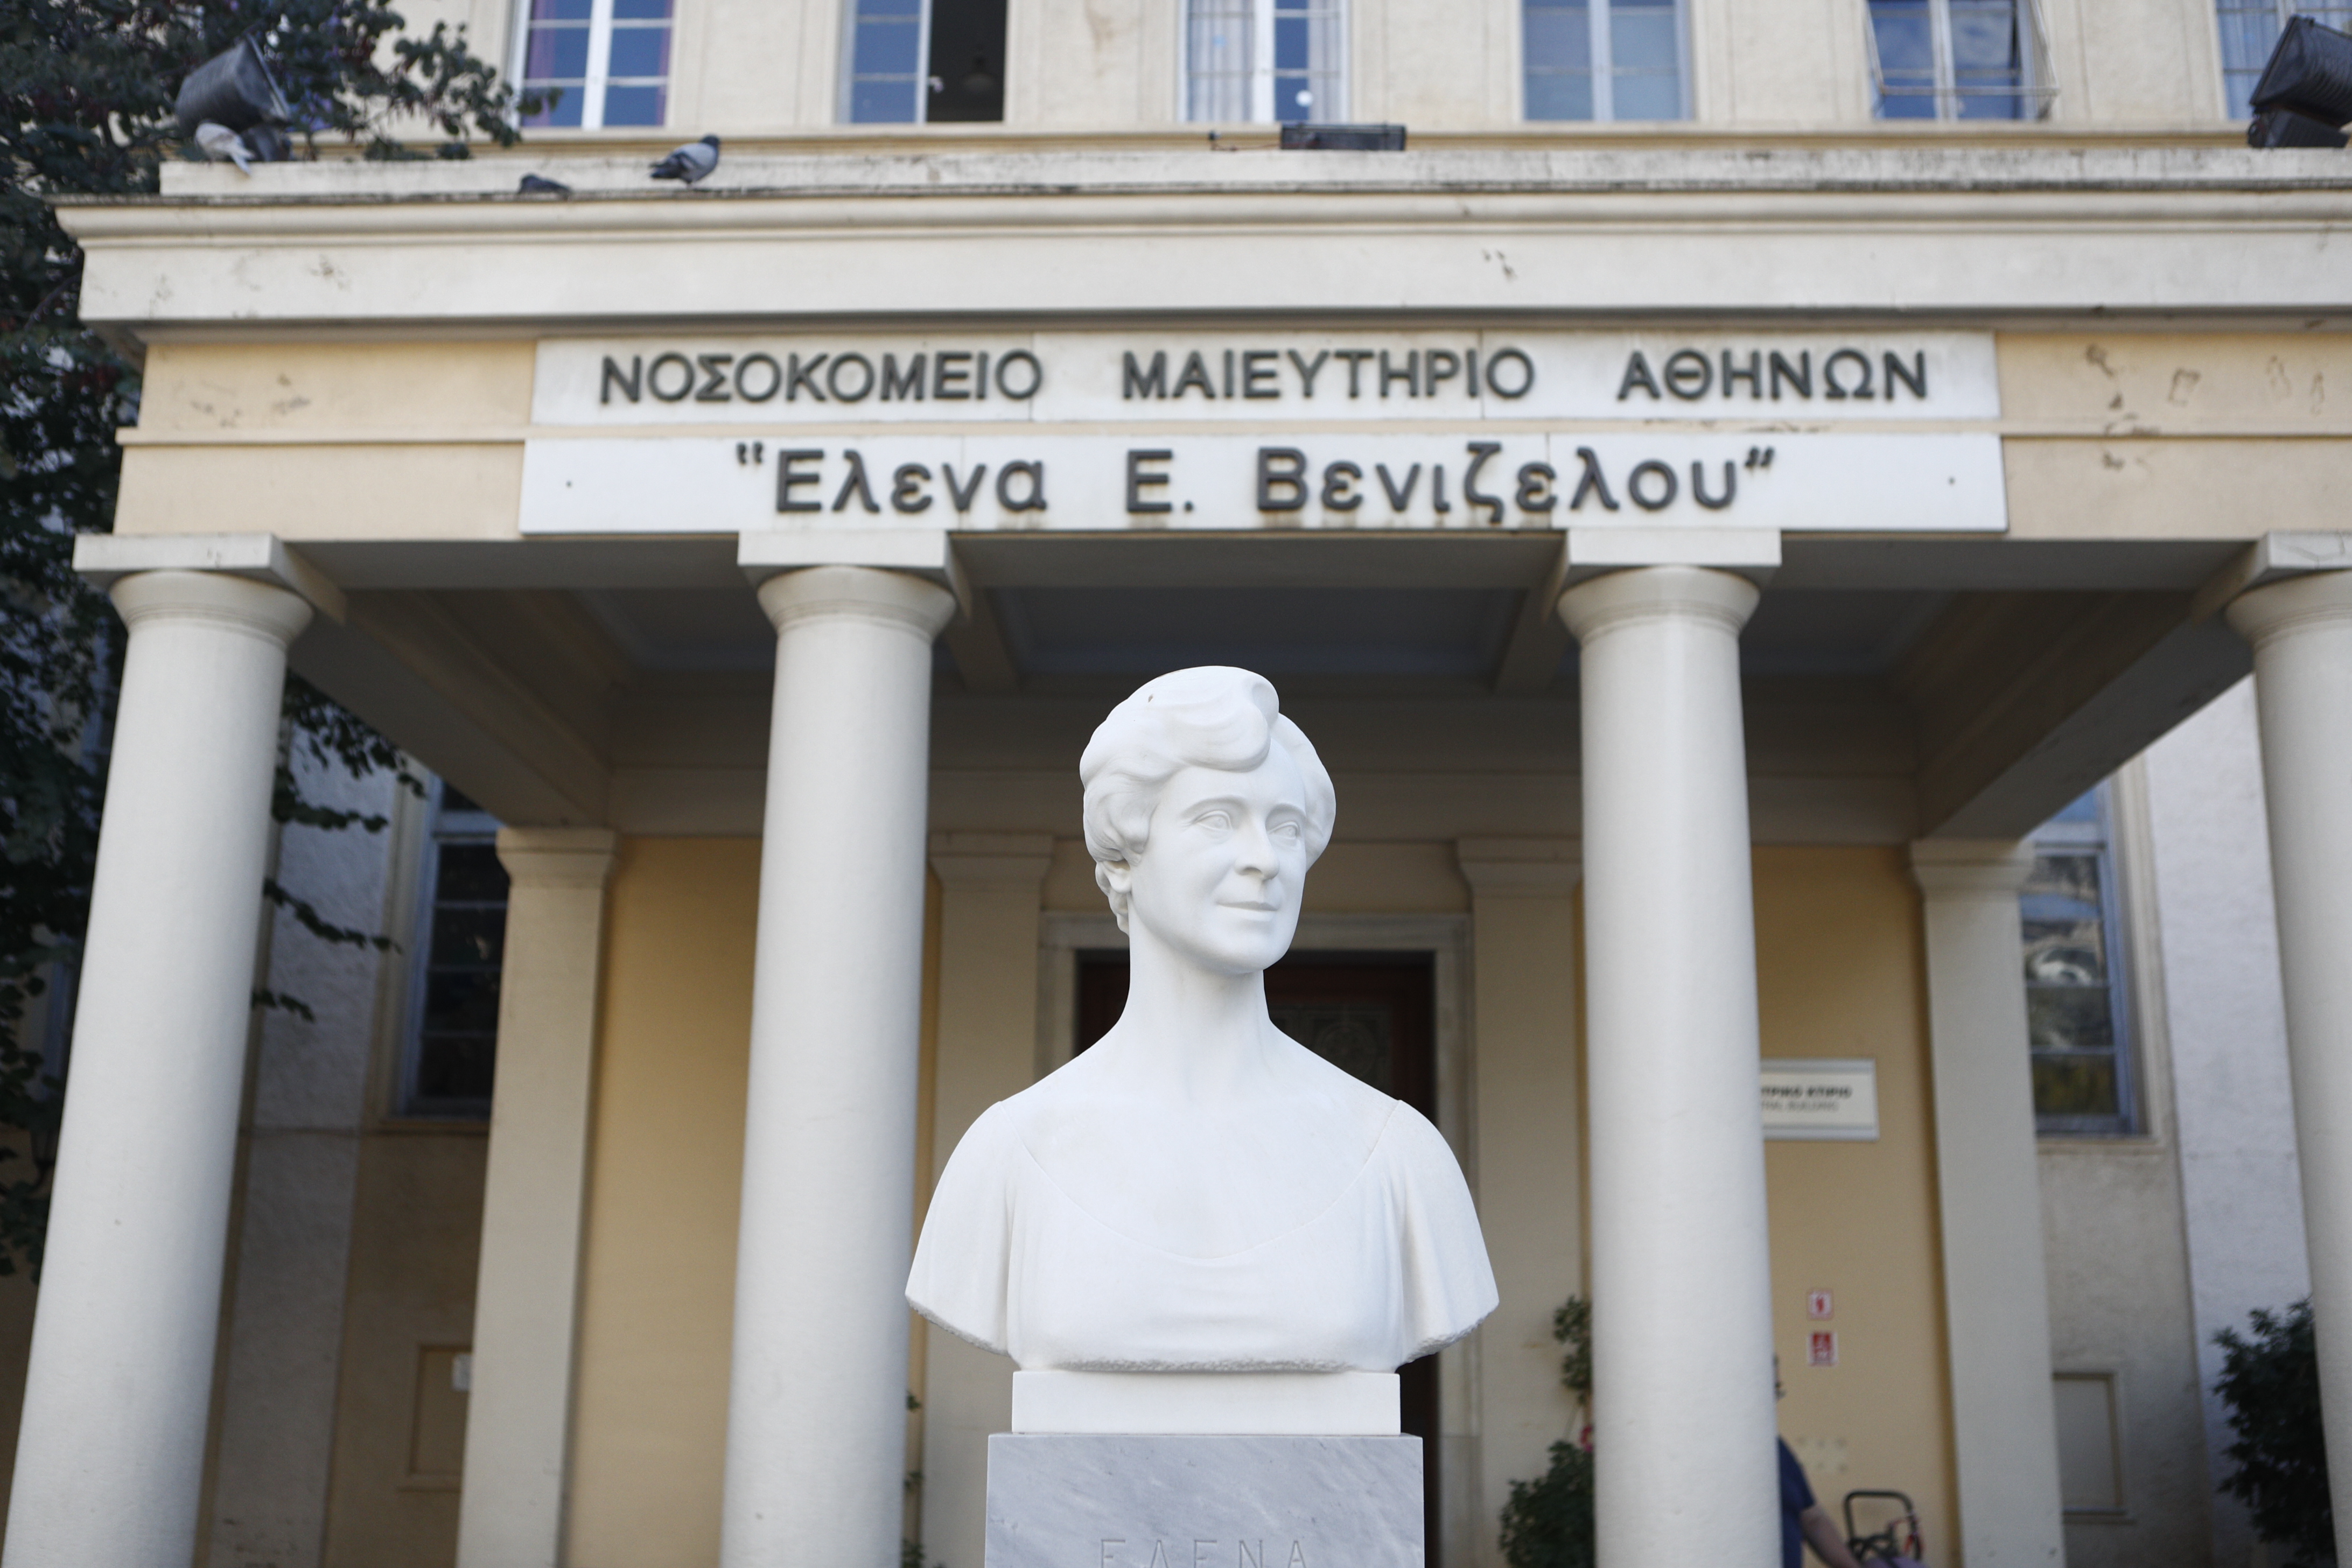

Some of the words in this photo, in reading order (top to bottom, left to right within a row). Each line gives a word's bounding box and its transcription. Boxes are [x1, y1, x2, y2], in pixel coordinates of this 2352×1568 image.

[600, 350, 1042, 404] ΝΟΣΟΚΟΜΕΙΟ
[1123, 348, 1535, 401] ΜΑΙΕΥΤΗΡΙΟ
[1617, 349, 1927, 401] ΑΘΗΝΩΝ
[1125, 450, 1194, 515] Ε.
